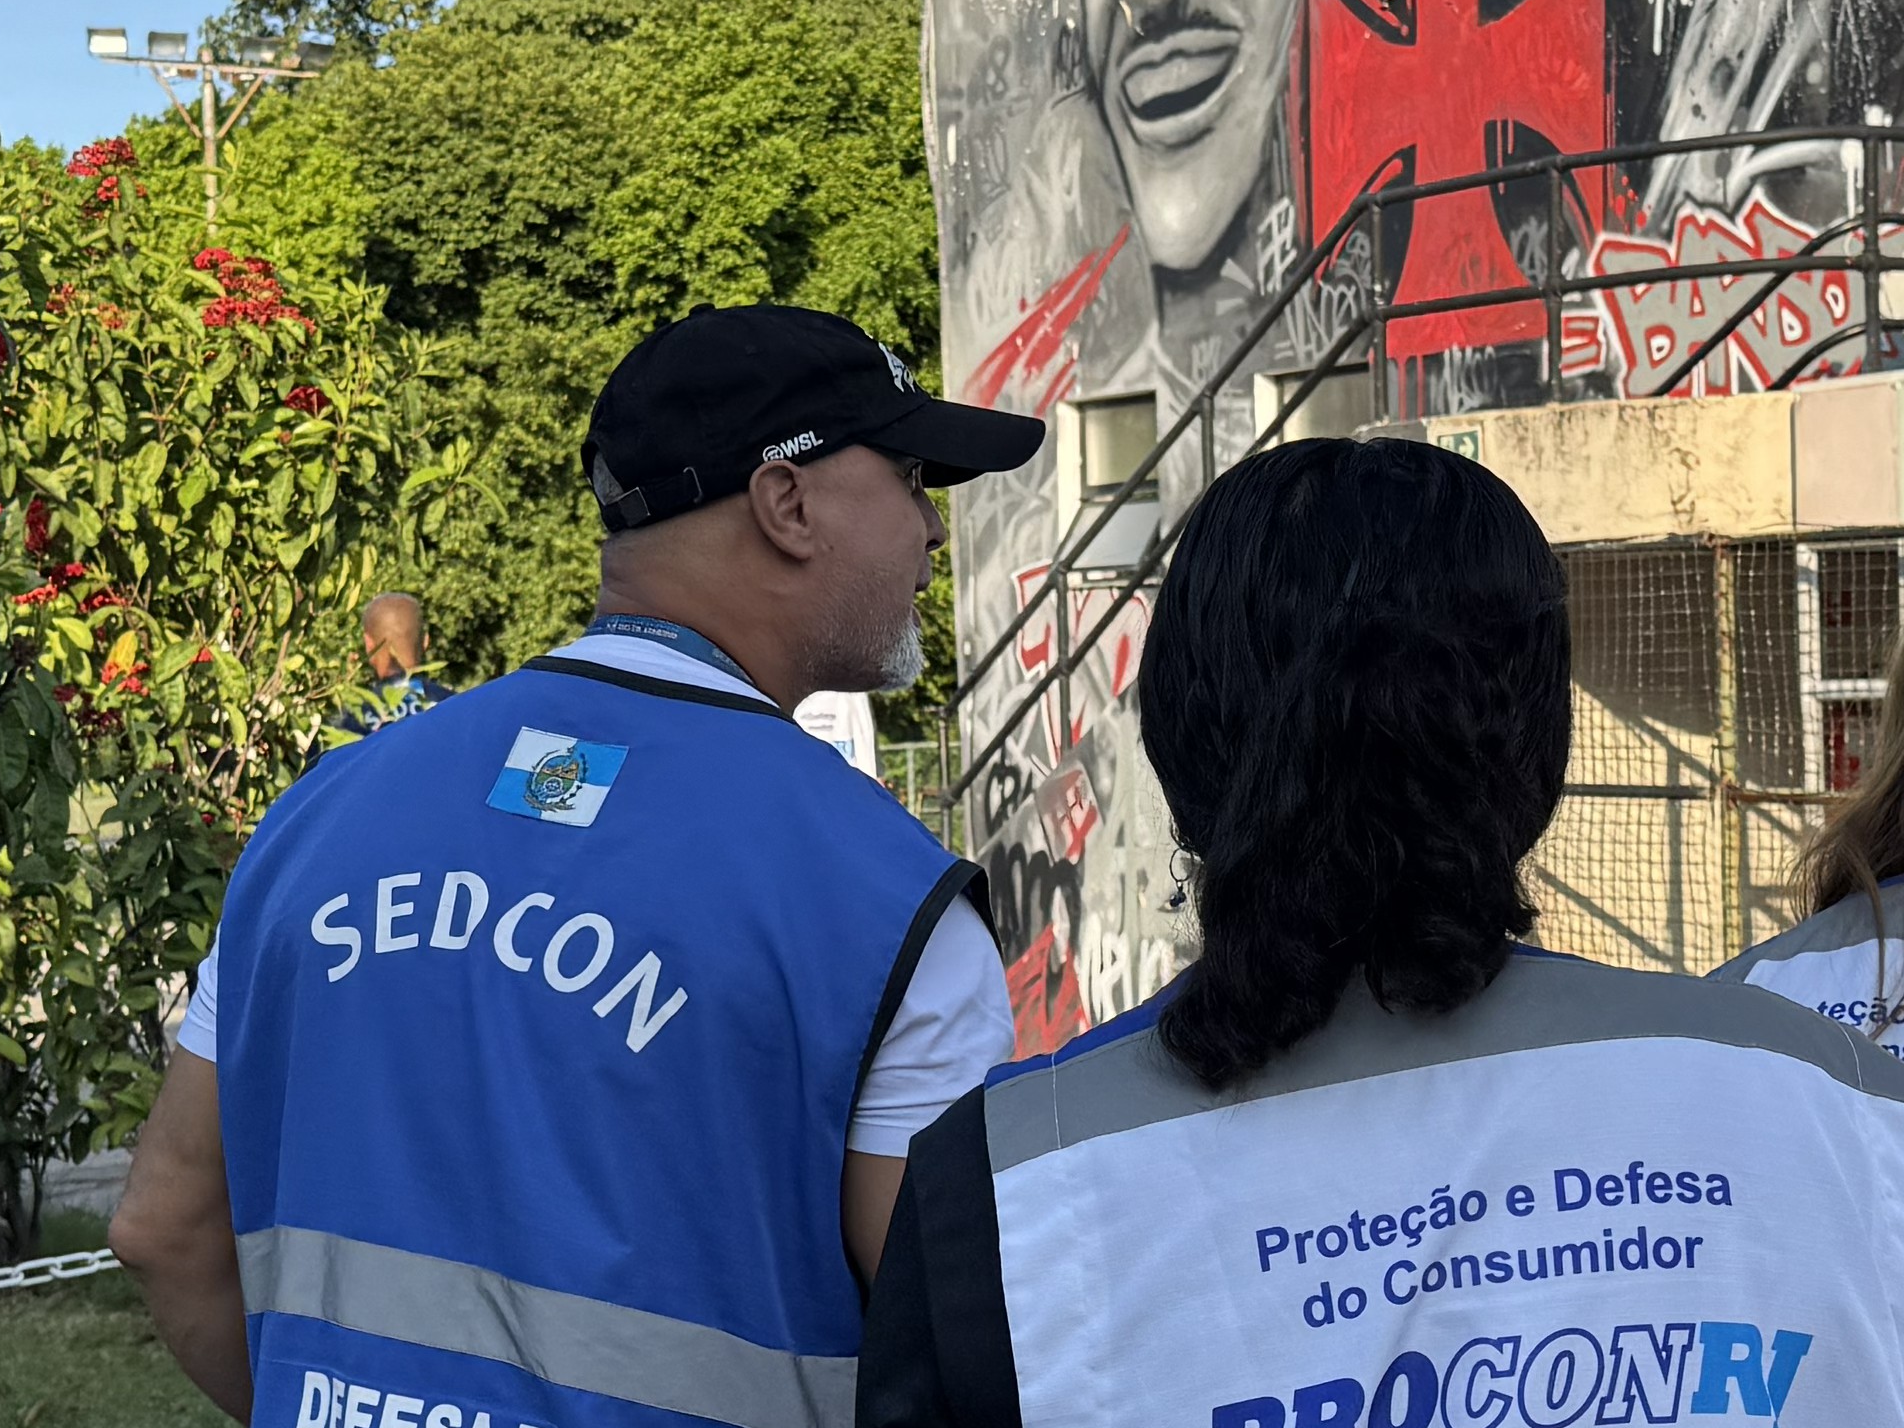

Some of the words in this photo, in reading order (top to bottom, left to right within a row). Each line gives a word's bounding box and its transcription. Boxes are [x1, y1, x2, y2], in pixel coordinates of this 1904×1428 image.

[780, 430, 824, 458] WSL
[310, 870, 689, 1053] SEDCON
[1255, 1184, 1488, 1273] Proteção
[1505, 1184, 1535, 1217] e
[1554, 1161, 1733, 1213] Defesa
[1302, 1281, 1368, 1328] do
[1383, 1226, 1704, 1305] Consumidor
